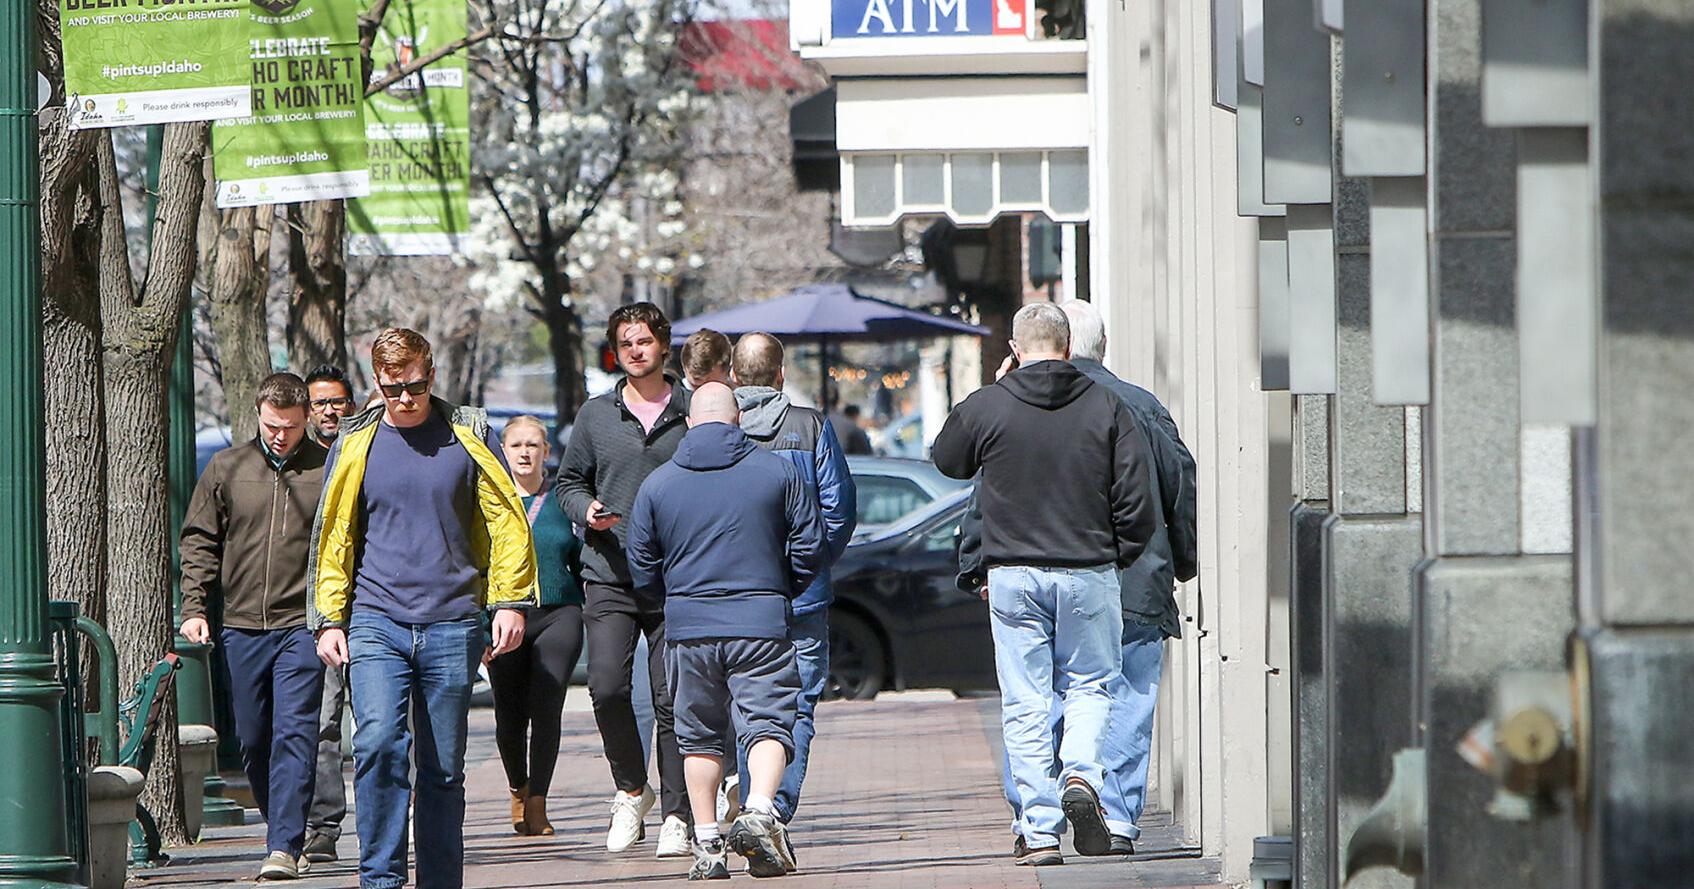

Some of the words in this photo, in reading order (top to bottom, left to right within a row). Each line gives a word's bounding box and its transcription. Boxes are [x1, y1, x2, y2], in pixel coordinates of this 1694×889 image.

[68, 16, 90, 27] AND
[92, 14, 116, 25] VISIT
[118, 12, 148, 24] YOUR
[150, 11, 184, 22] LOCAL
[187, 9, 240, 21] BREWERY!
[280, 7, 314, 25] SEASON
[856, 0, 970, 34] ATM
[250, 37, 331, 58] LEBRATE
[102, 59, 202, 80] #pintsupIdaho
[287, 57, 354, 82] CRAFT
[142, 103, 169, 111] Please
[170, 101, 191, 110] drink
[193, 98, 239, 110] responsibly
[273, 83, 356, 110] MONTH!
[215, 119, 236, 128] AND
[236, 116, 257, 126] VISIT
[259, 114, 283, 124] YOUR
[284, 112, 313, 122] LOCAL
[314, 110, 357, 120] BREWERY!
